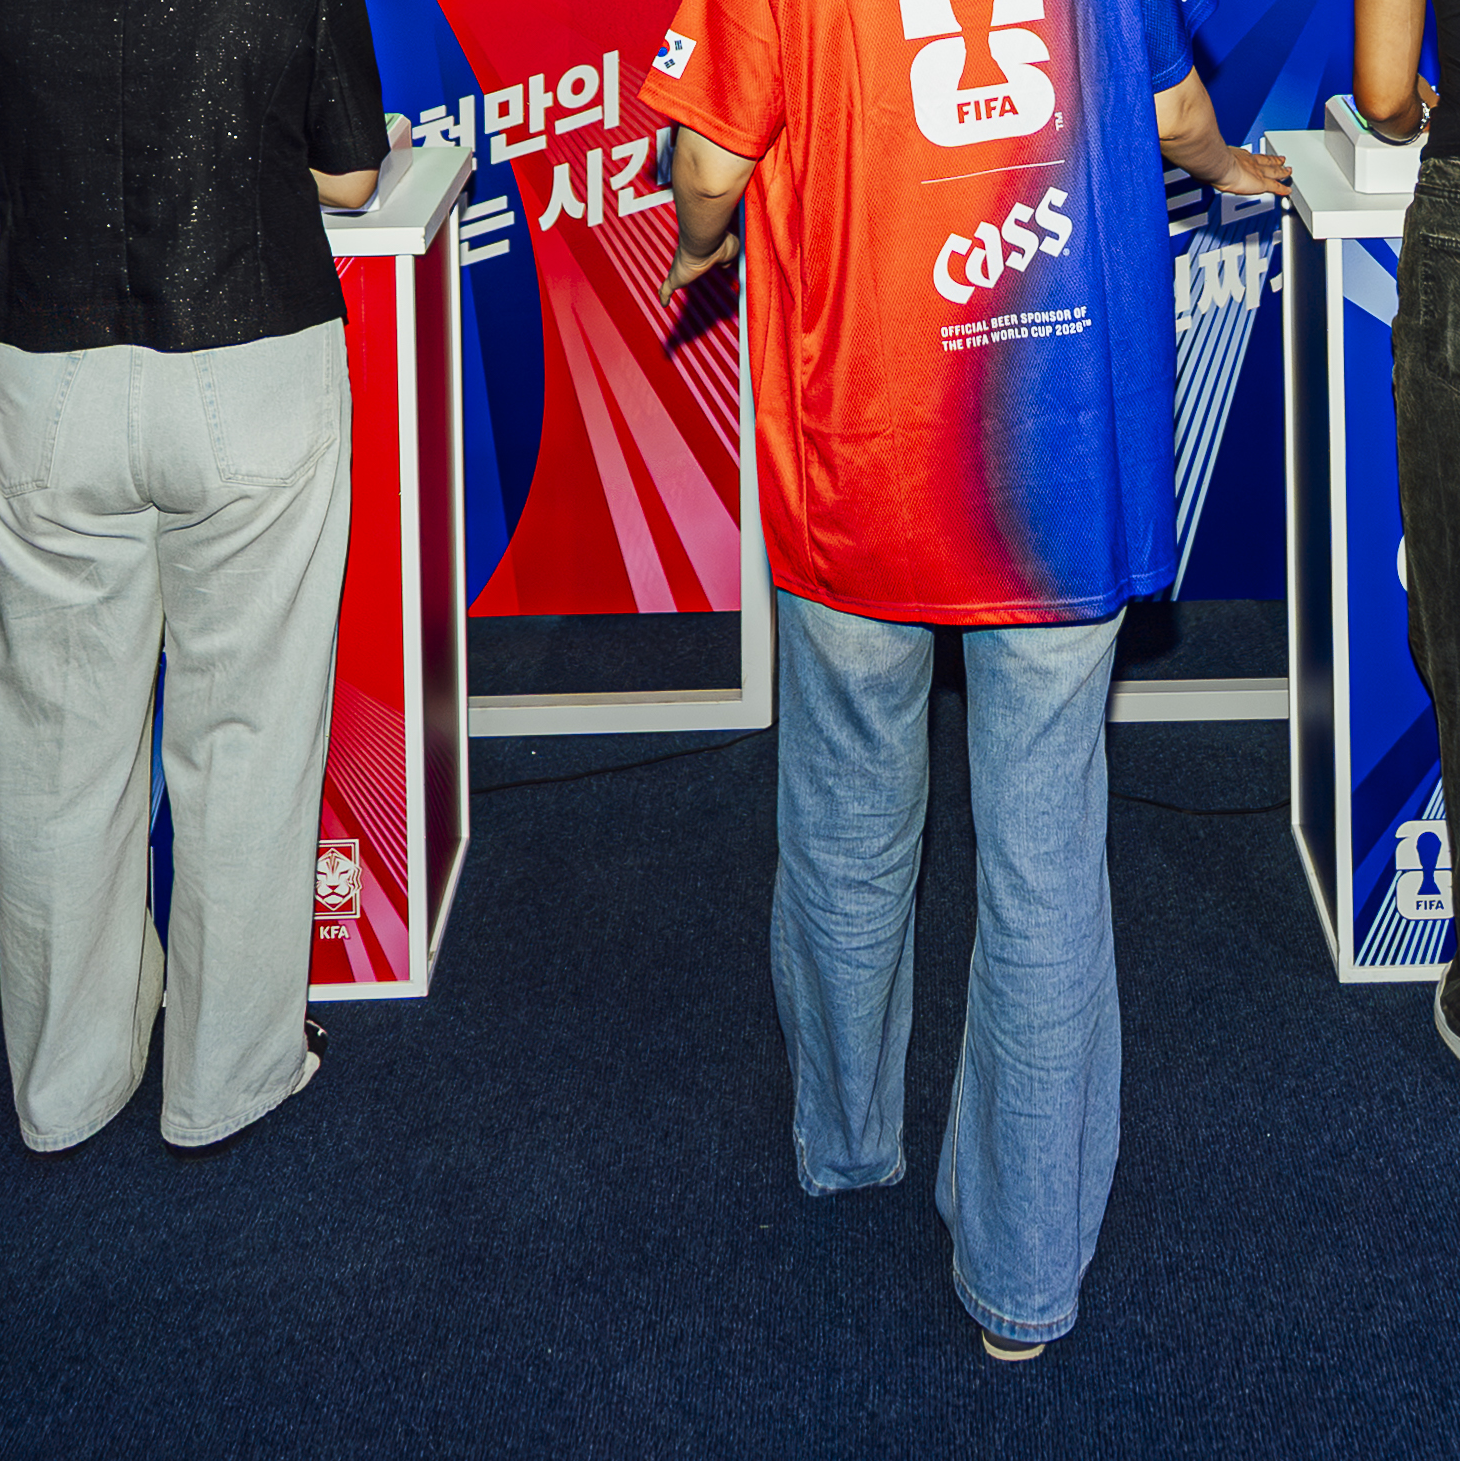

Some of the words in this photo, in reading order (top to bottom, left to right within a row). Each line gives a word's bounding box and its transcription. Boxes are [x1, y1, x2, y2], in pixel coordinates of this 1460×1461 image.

[956, 95, 1019, 125] FIFA
[940, 320, 989, 338] OFFICIAL
[990, 314, 1019, 329] BEER
[1020, 308, 1071, 325] SPONSOR
[1073, 306, 1088, 319] OF
[942, 339, 964, 352] THE
[966, 335, 989, 349] FIFA
[990, 327, 1029, 343] WORLD
[1031, 325, 1053, 338] CUP
[1415, 900, 1445, 911] FIFA
[319, 925, 350, 940] KFA
